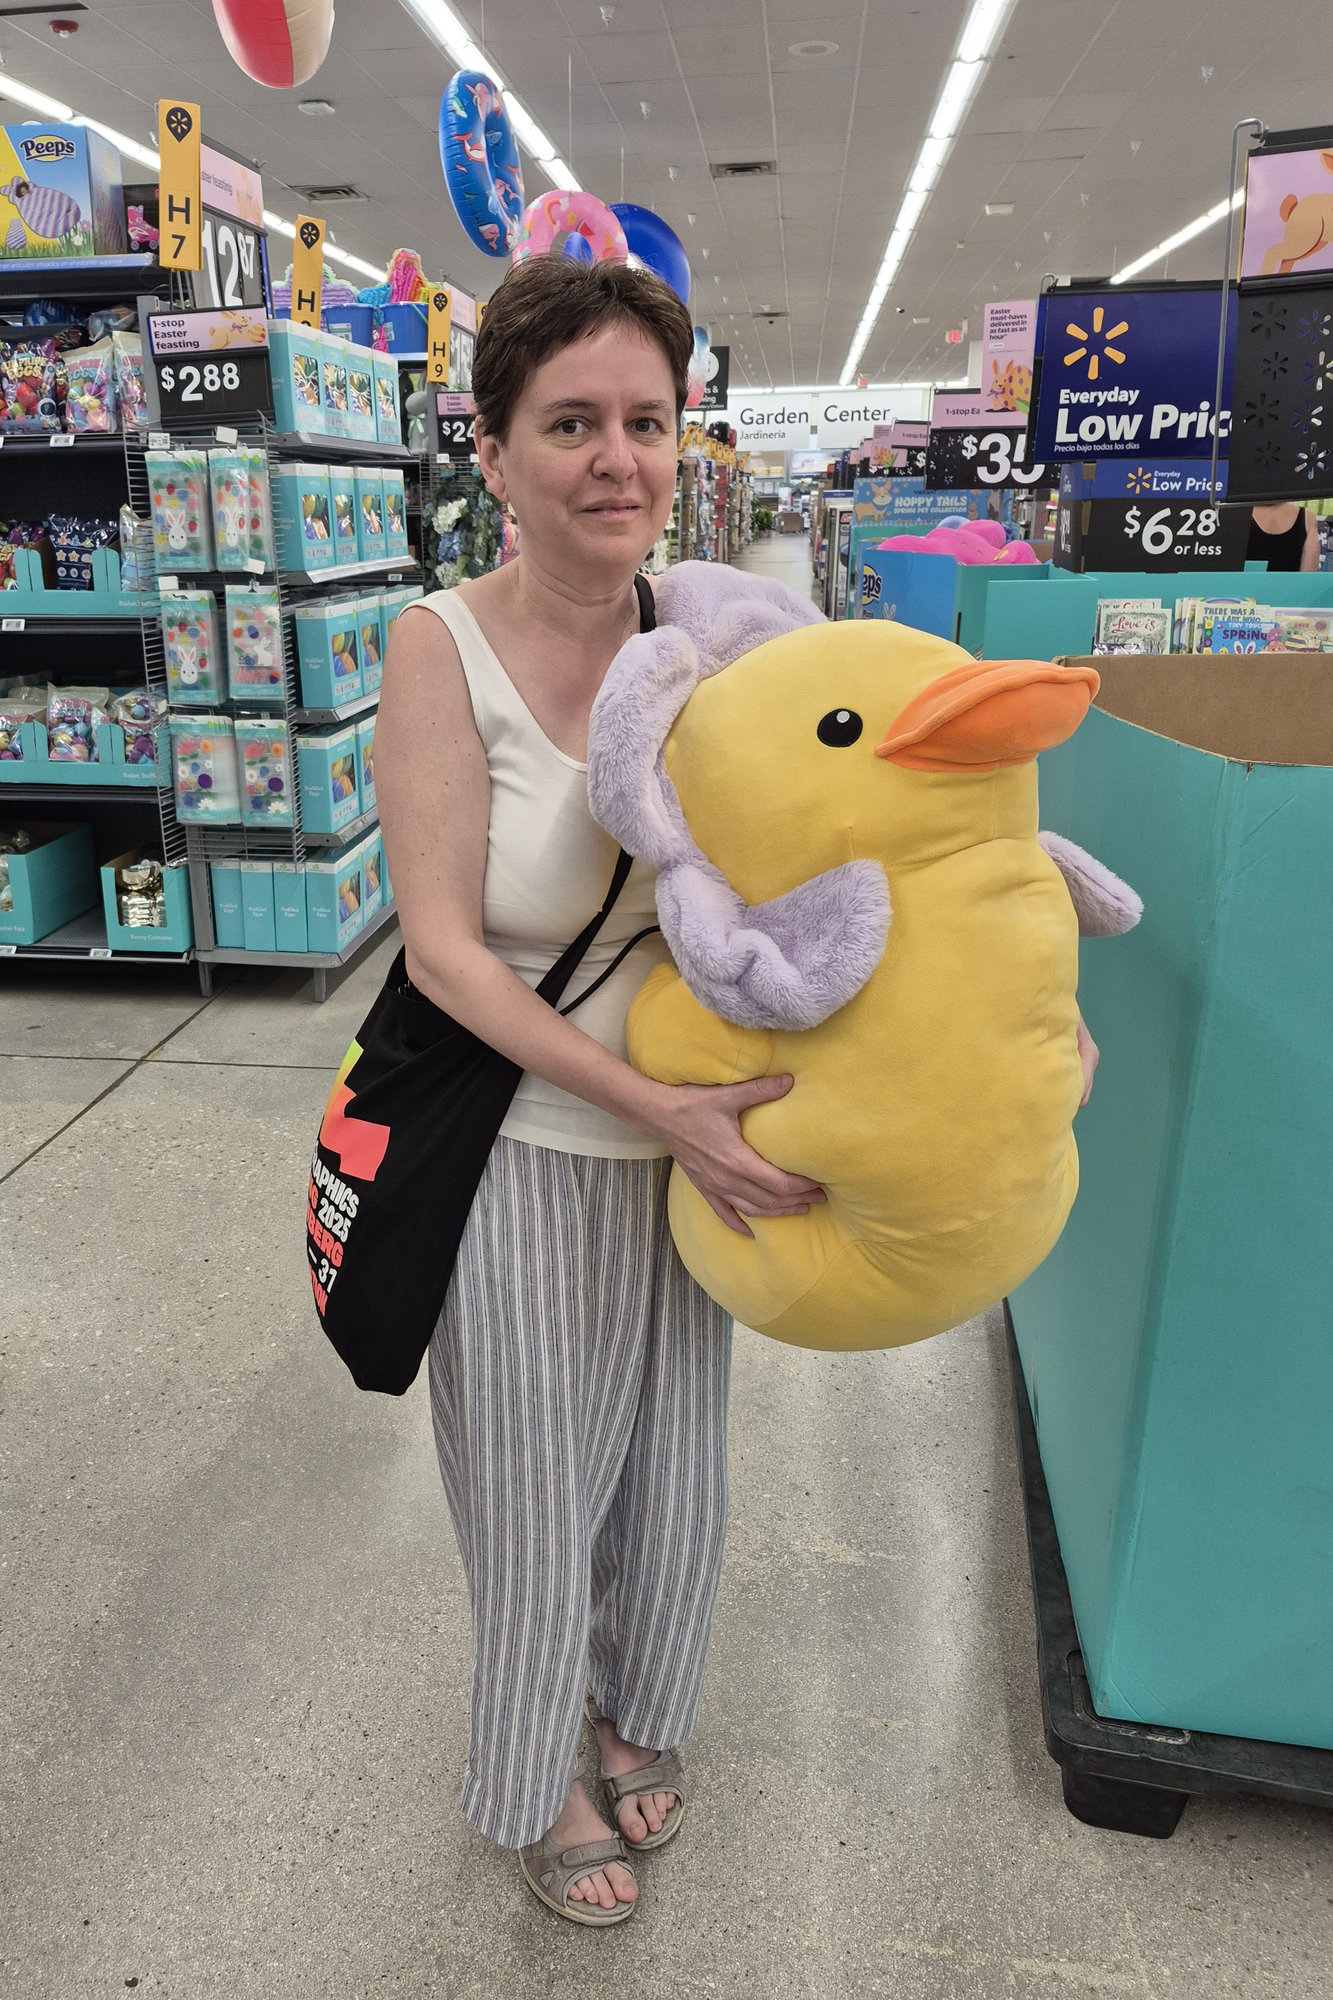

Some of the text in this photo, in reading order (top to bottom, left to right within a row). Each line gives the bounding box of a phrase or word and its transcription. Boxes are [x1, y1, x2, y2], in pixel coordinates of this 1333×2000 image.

[20, 139, 75, 157] Peeps
[168, 194, 190, 224] H
[171, 235, 186, 259] 7
[298, 289, 315, 313] H
[152, 319, 185, 328] 1-stop
[154, 330, 187, 338] Easter
[156, 340, 200, 350] feasting
[433, 341, 446, 357] H
[434, 363, 443, 378] 9
[1059, 386, 1140, 407] Everyday
[740, 404, 891, 425] Garden Center
[946, 408, 970, 416] 1-stop
[1055, 401, 1232, 443] Low Pric
[1076, 444, 1092, 453] bajo
[1093, 443, 1113, 451] todos
[961, 432, 1046, 484] $35
[1152, 477, 1223, 491] Low Price
[894, 495, 967, 508] HOPPY TAILS
[1174, 541, 1222, 555] or less
[863, 574, 881, 598] eps
[1204, 607, 1228, 616] THERE
[1230, 607, 1247, 616] WAS
[1111, 616, 1156, 634] Love is
[318, 1197, 352, 1243] 2025
[306, 1203, 344, 1268] BERG
